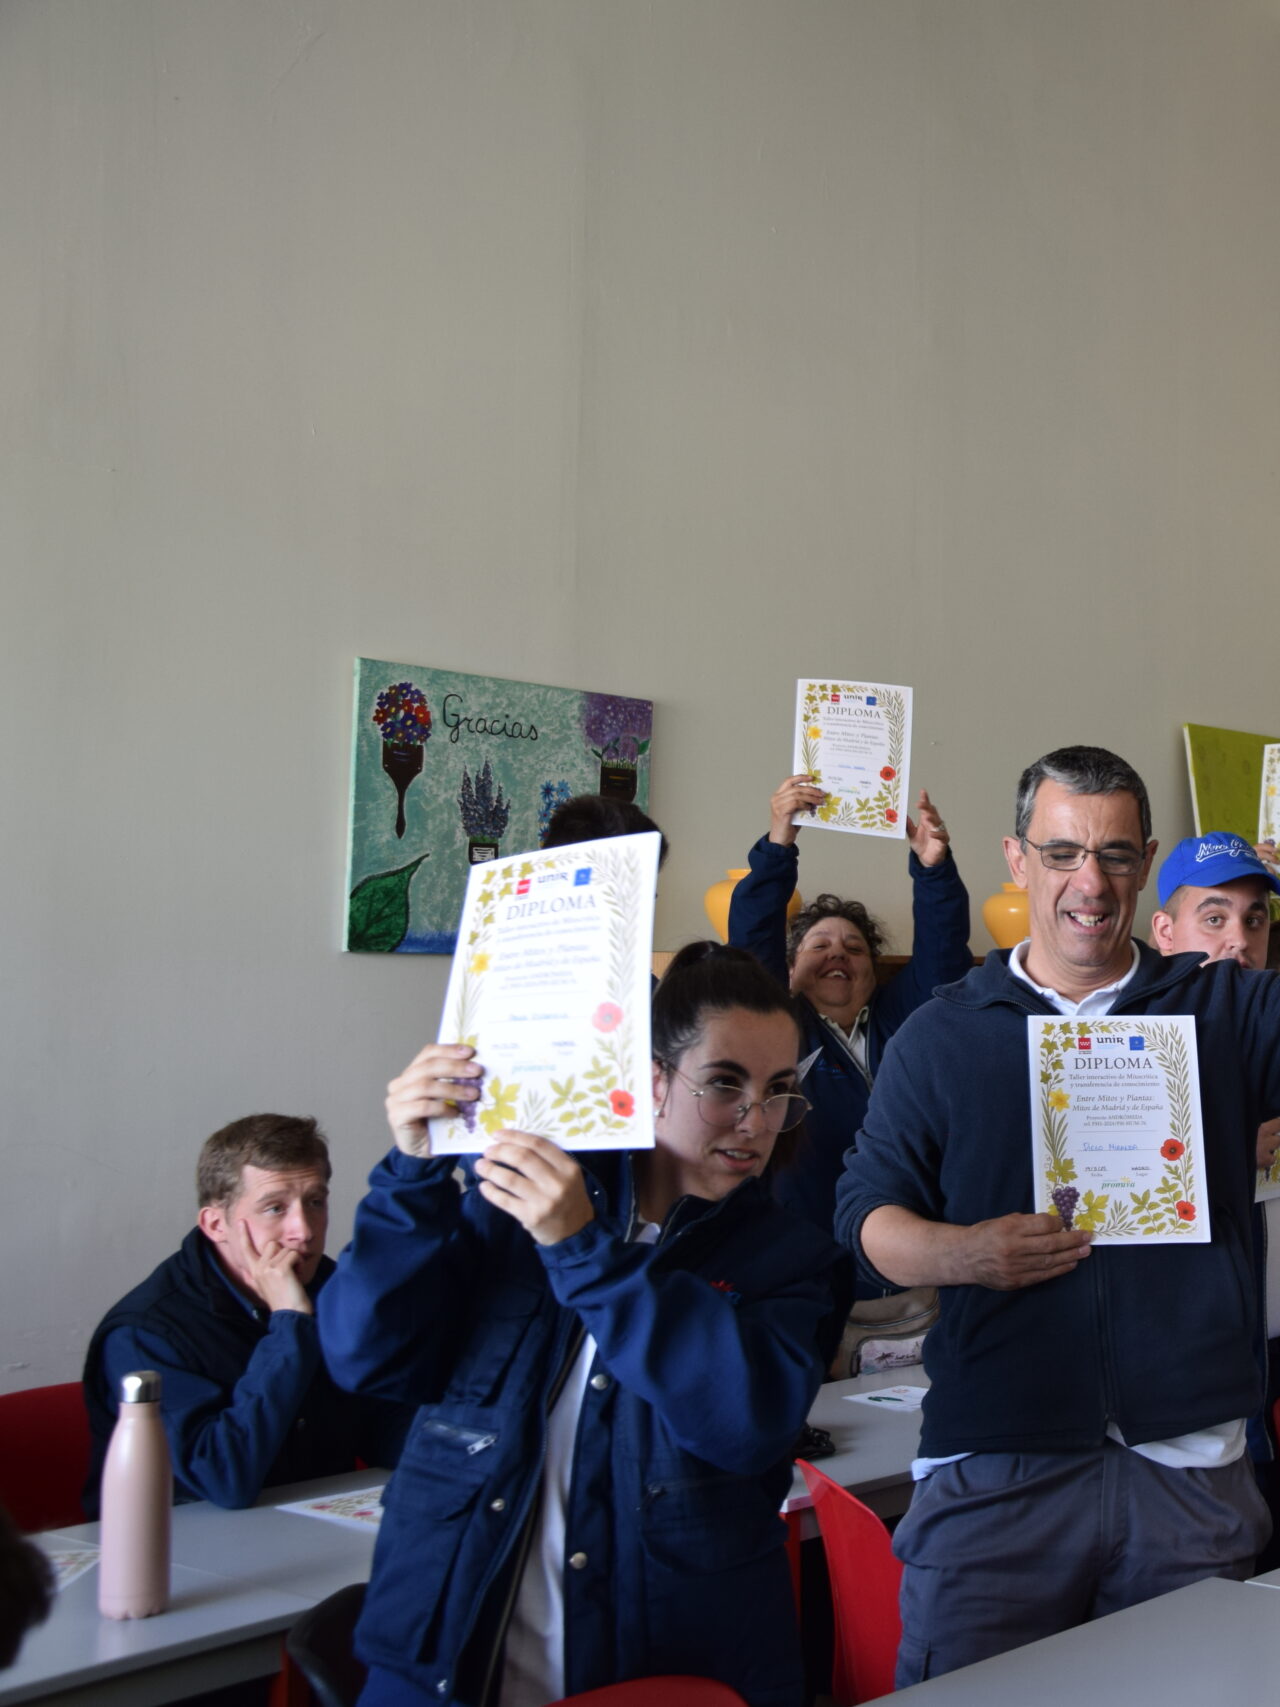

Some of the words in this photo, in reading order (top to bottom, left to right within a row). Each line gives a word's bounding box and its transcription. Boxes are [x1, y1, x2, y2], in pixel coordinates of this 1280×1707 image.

[442, 693, 539, 744] Gracias
[827, 706, 881, 720] DIPLOMA
[505, 894, 597, 921] DIPLOMA
[1074, 1057, 1153, 1070] DIPLOMA
[1140, 1103, 1164, 1111] España
